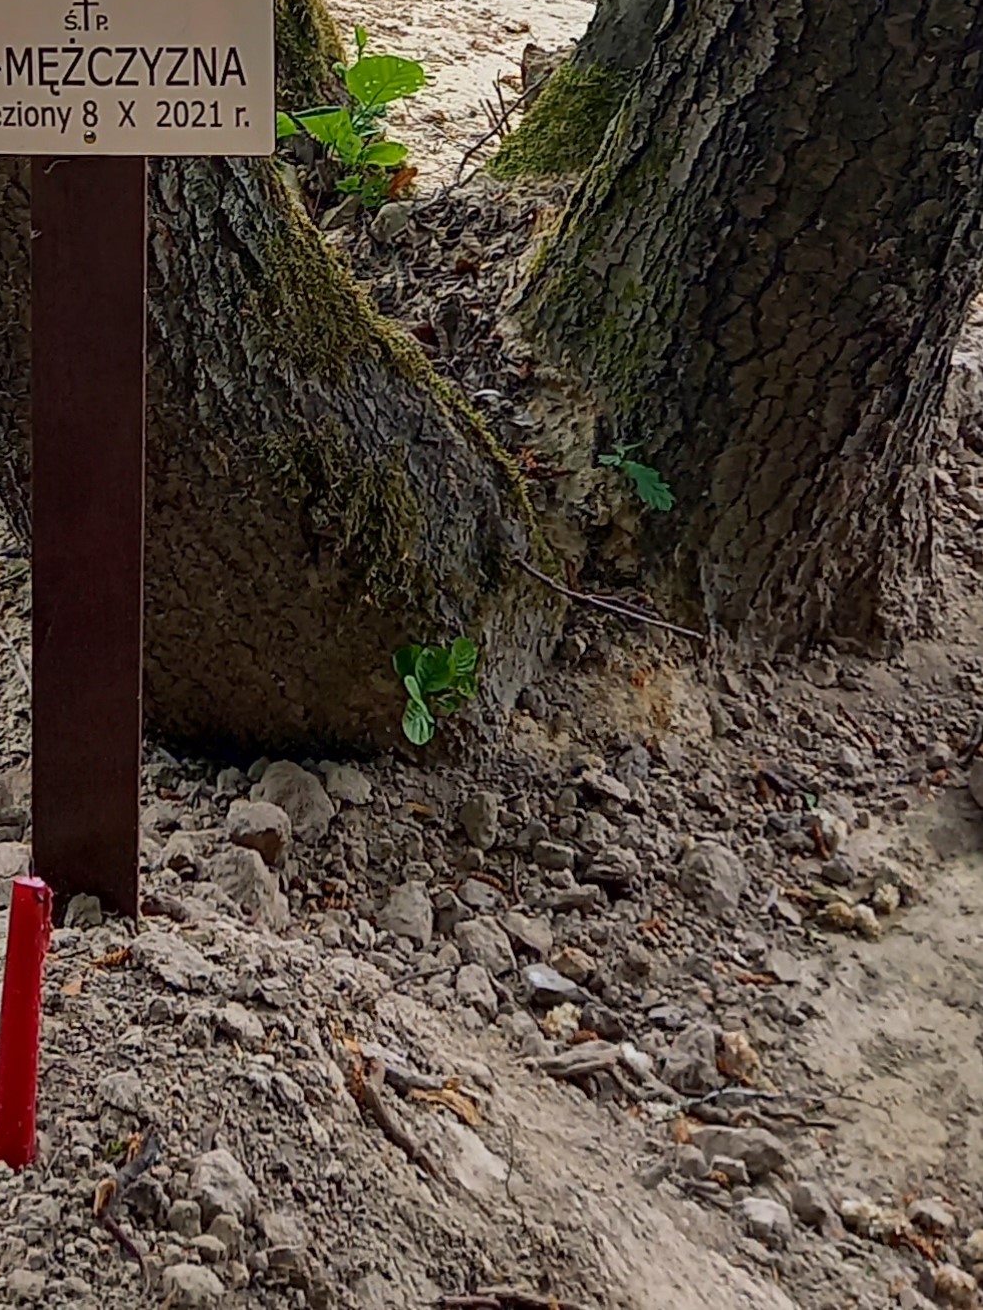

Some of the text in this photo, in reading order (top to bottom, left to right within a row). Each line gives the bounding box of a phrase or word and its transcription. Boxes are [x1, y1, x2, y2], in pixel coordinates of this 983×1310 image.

[82, 100, 98, 127] 8
[118, 100, 136, 128] X
[156, 100, 223, 128] 2021
[234, 105, 250, 128] r.
